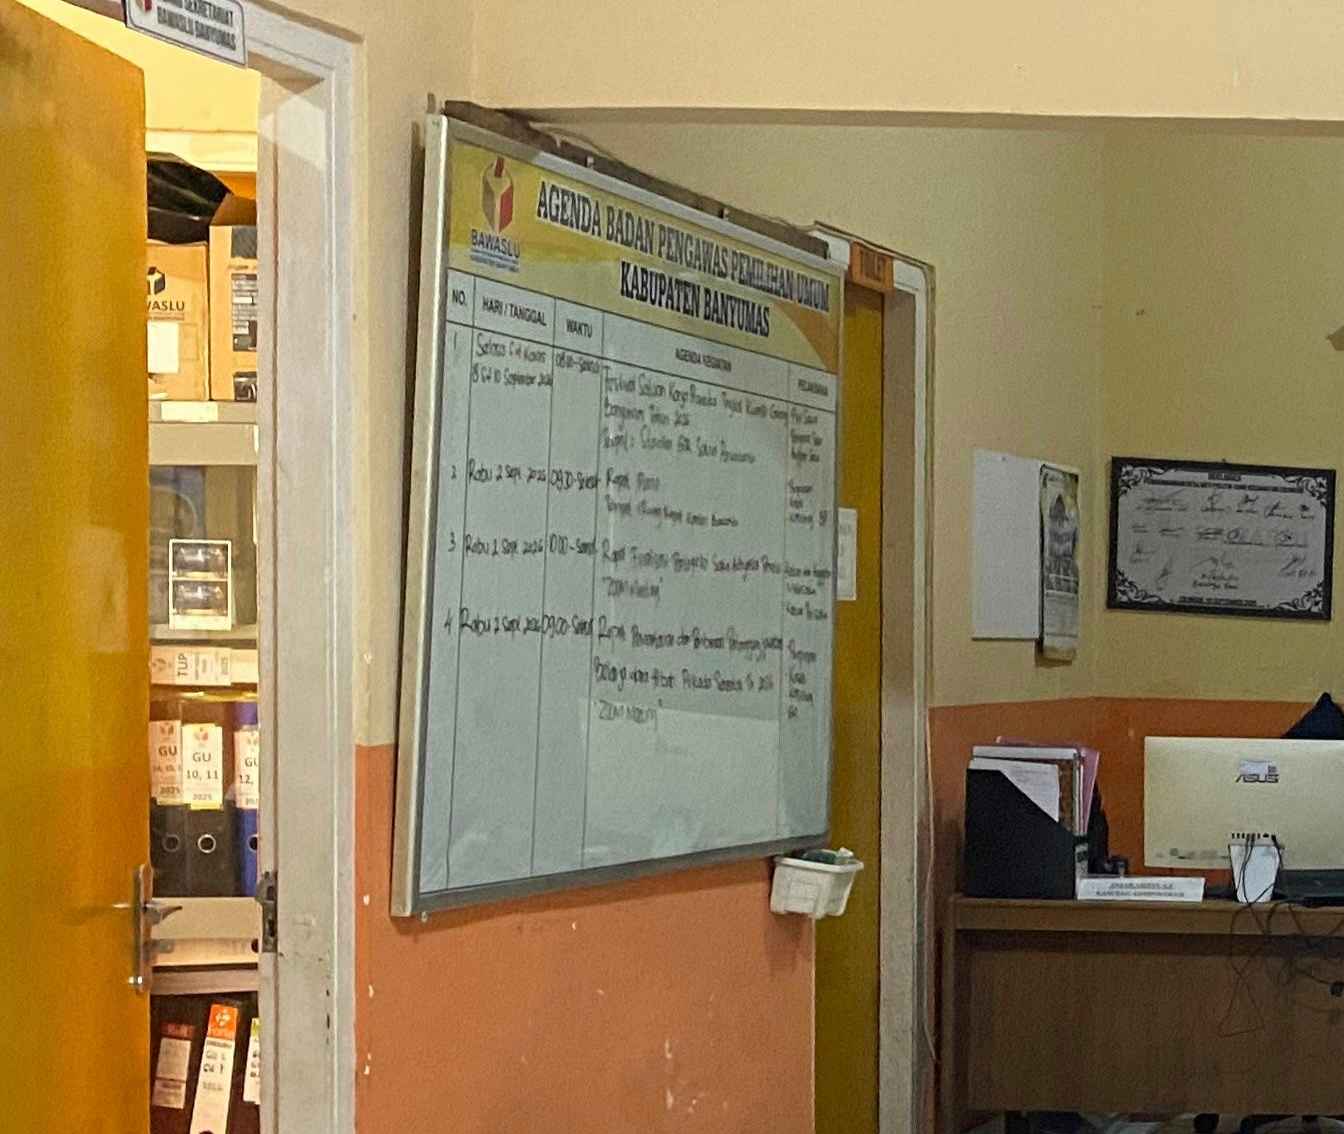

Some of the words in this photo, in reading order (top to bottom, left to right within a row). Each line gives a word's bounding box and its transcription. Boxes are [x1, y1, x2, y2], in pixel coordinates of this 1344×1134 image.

[471, 228, 521, 258] BAWASLU
[536, 180, 601, 237] AGENDA
[606, 205, 653, 257] BADAN
[657, 224, 729, 280] PENGAWAS
[730, 250, 795, 302] PEMILIHAN
[148, 299, 185, 312] ASLU
[619, 260, 701, 320] KABUPATEN
[703, 287, 770, 338] BANYUMAS
[509, 303, 547, 327] TANGGAL
[566, 319, 593, 338] WAKTU
[158, 745, 177, 757] GU
[192, 752, 211, 762] GU
[186, 770, 200, 781] 10,
[207, 770, 219, 780] 11
[1235, 774, 1280, 784] ASUS
